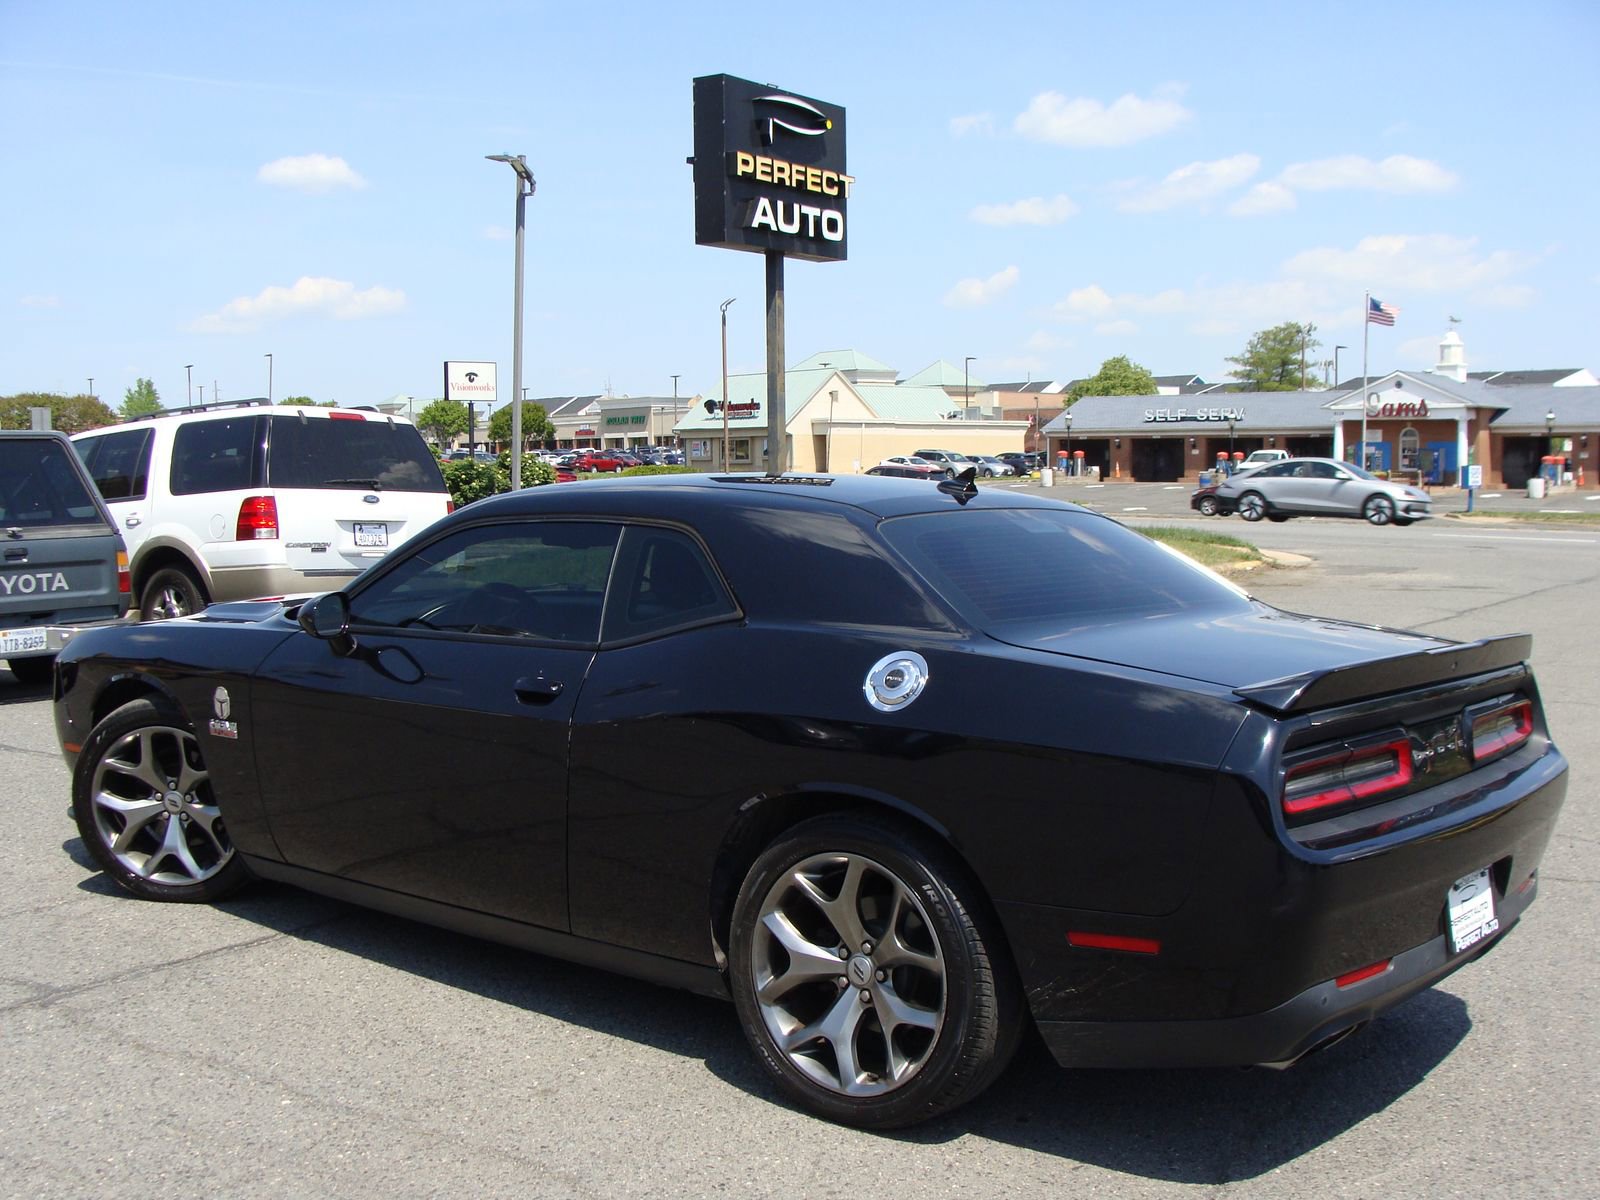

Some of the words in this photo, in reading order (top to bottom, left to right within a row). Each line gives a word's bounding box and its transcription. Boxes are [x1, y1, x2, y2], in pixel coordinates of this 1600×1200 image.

[736, 151, 855, 198] PERFECT
[751, 196, 844, 241] AUTO
[450, 382, 495, 391] Visionworks
[1144, 408, 1187, 421] SELF
[1196, 407, 1244, 420] SERV
